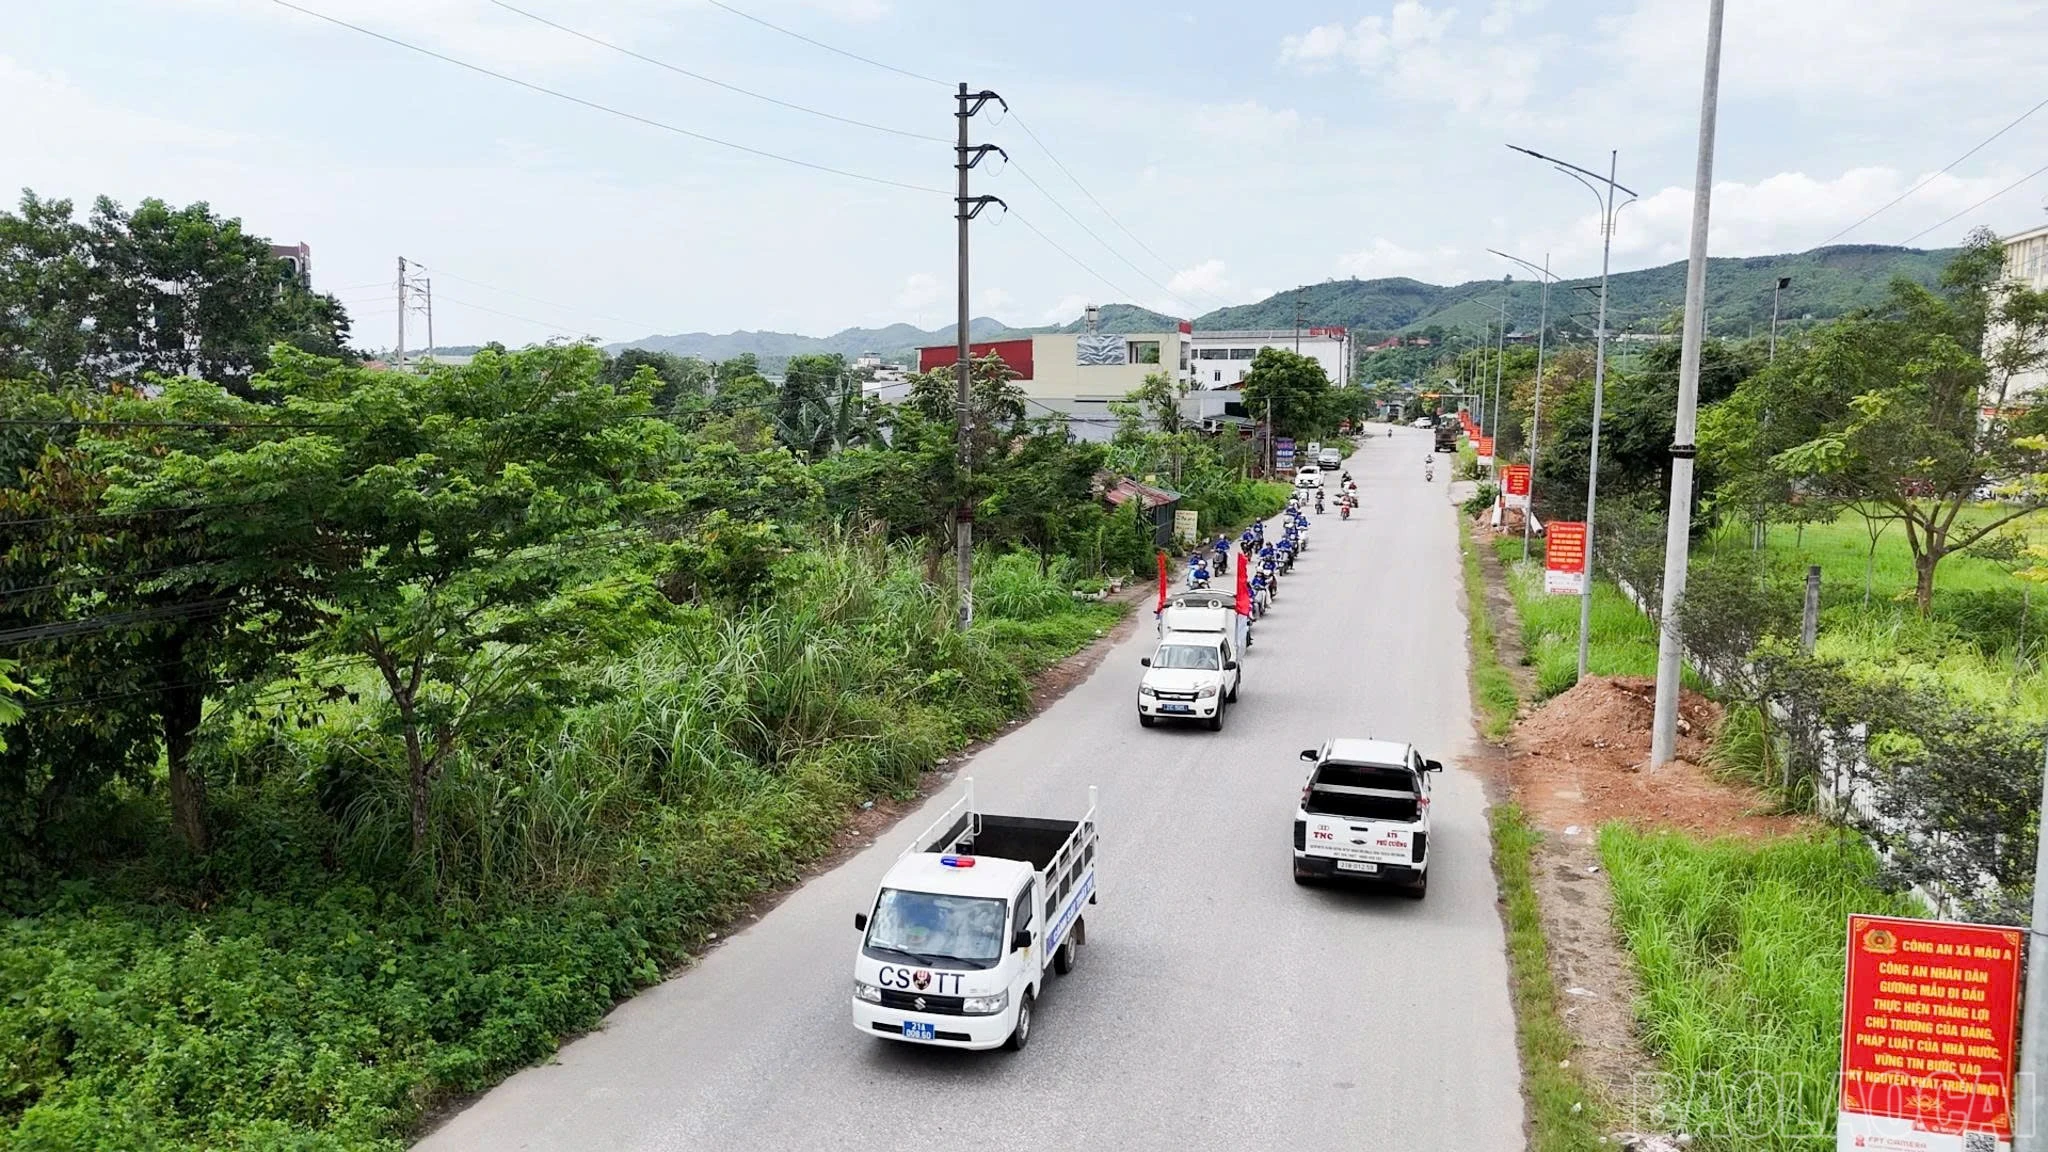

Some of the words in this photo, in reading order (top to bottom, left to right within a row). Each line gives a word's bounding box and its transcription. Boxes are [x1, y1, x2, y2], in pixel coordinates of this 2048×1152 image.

[1313, 831, 1334, 840] TNC
[1902, 939, 1934, 953] CÔNG
[1936, 943, 1953, 955] AN
[2002, 949, 2012, 960] A
[1879, 961, 1909, 976] CÔNG
[1912, 965, 1928, 978] AN
[1930, 966, 1962, 981] NHÂN
[1964, 968, 1989, 983] DÂN
[1879, 981, 1917, 995] GƯƠNG
[1947, 987, 1960, 999] ĐI
[1962, 985, 1985, 1002] ĐẦU
[1873, 998, 1901, 1014] THỰC
[1903, 1000, 1930, 1016] HIỆN
[1932, 1001, 1969, 1019] THẮNG
[1971, 1008, 1990, 1022] LỢI
[1865, 1014, 1888, 1029] CHỦ
[1890, 1018, 1933, 1034] TRƯƠNG
[1935, 1021, 1958, 1036] CỦA
[1856, 1032, 1885, 1047] PHÁP
[1888, 1036, 1915, 1052] LUẬT
[1917, 1037, 1940, 1053] CỦA
[1942, 1040, 1965, 1056] NHÀ
[1874, 1052, 1904, 1068] VỮNG
[1907, 1056, 1924, 1070] TIN
[1926, 1058, 1957, 1073] BƯỚC
[1959, 1062, 1981, 1076] VÀO
[1865, 1070, 1909, 1086] NGUYÊN
